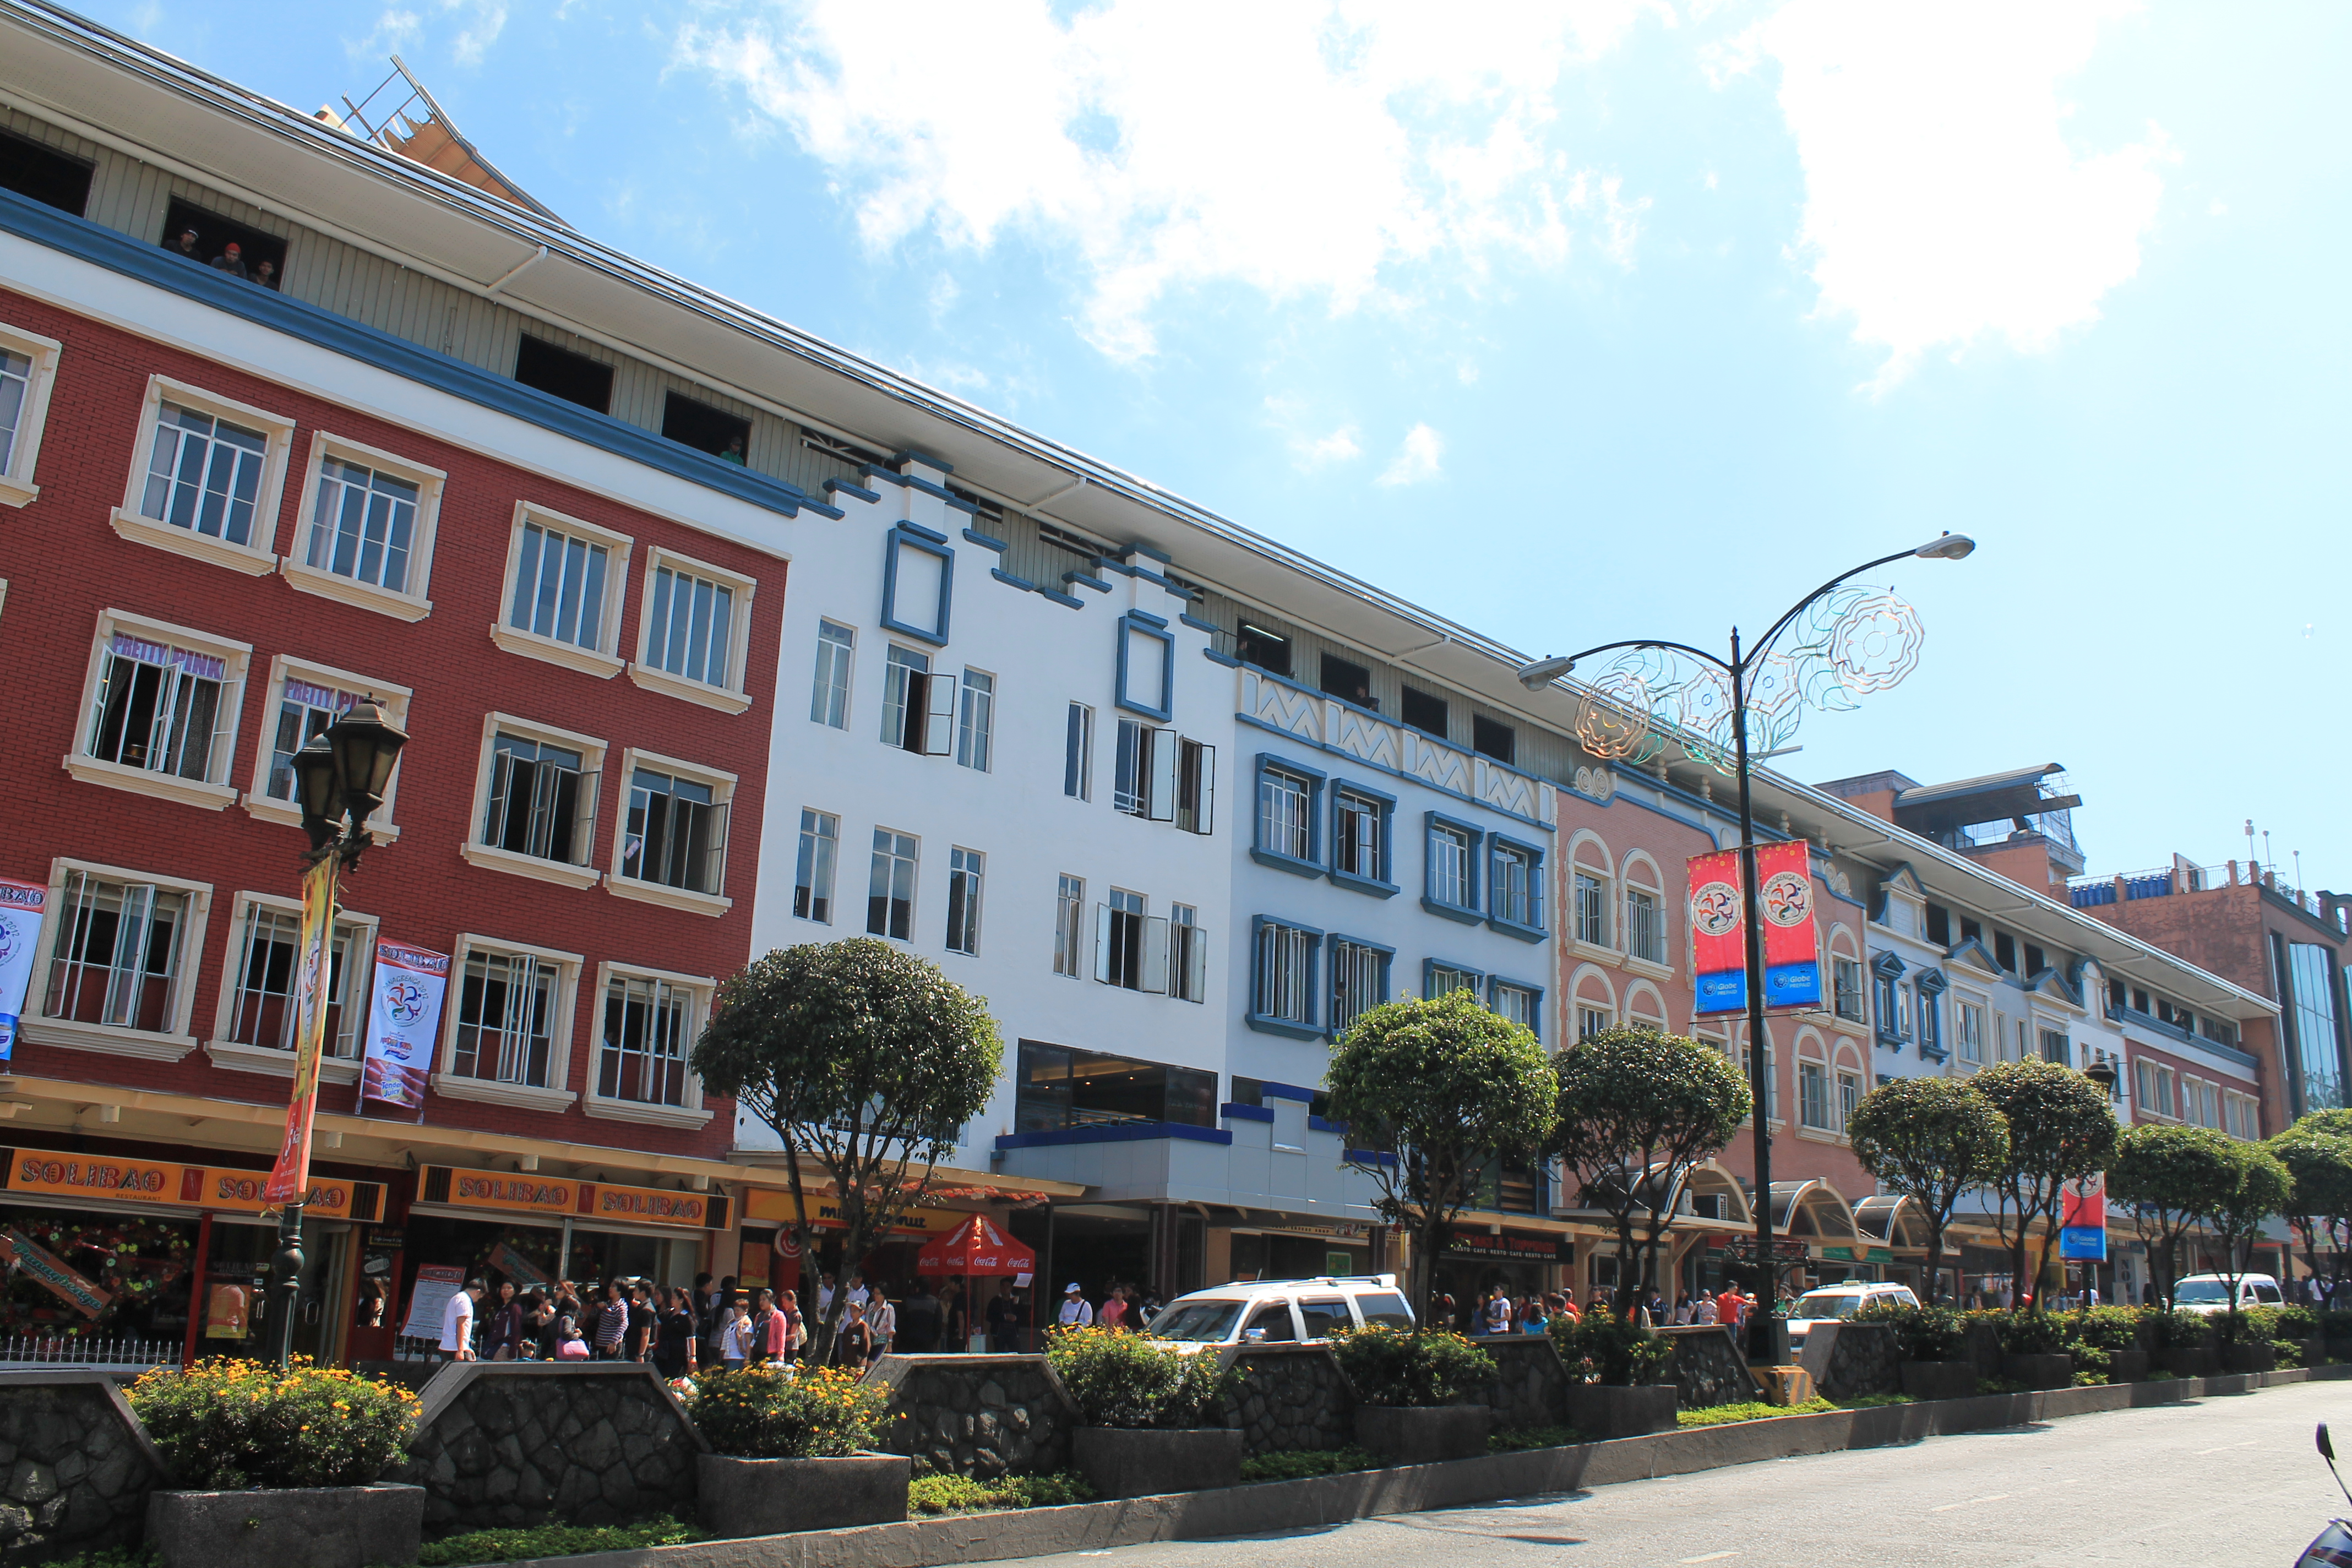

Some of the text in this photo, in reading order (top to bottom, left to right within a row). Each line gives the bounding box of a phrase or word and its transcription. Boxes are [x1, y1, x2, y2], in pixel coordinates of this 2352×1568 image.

[113, 630, 226, 679] PRETTY PINK
[284, 677, 386, 715] PRETTY PI
[1725, 888, 1738, 901] 2012
[1796, 878, 1808, 891] 2012
[6, 921, 20, 937] 2012
[378, 945, 448, 971] SOLIBAO
[418, 984, 429, 1000] 2012
[384, 1088, 400, 1097] Juicy
[20, 1159, 166, 1193] SOLIBAO
[116, 1193, 161, 1201] RESTAURANT
[458, 1177, 569, 1206] SOLIBAO
[602, 1192, 703, 1219] SOLIBAO
[11, 1242, 102, 1309] Panagbenga
